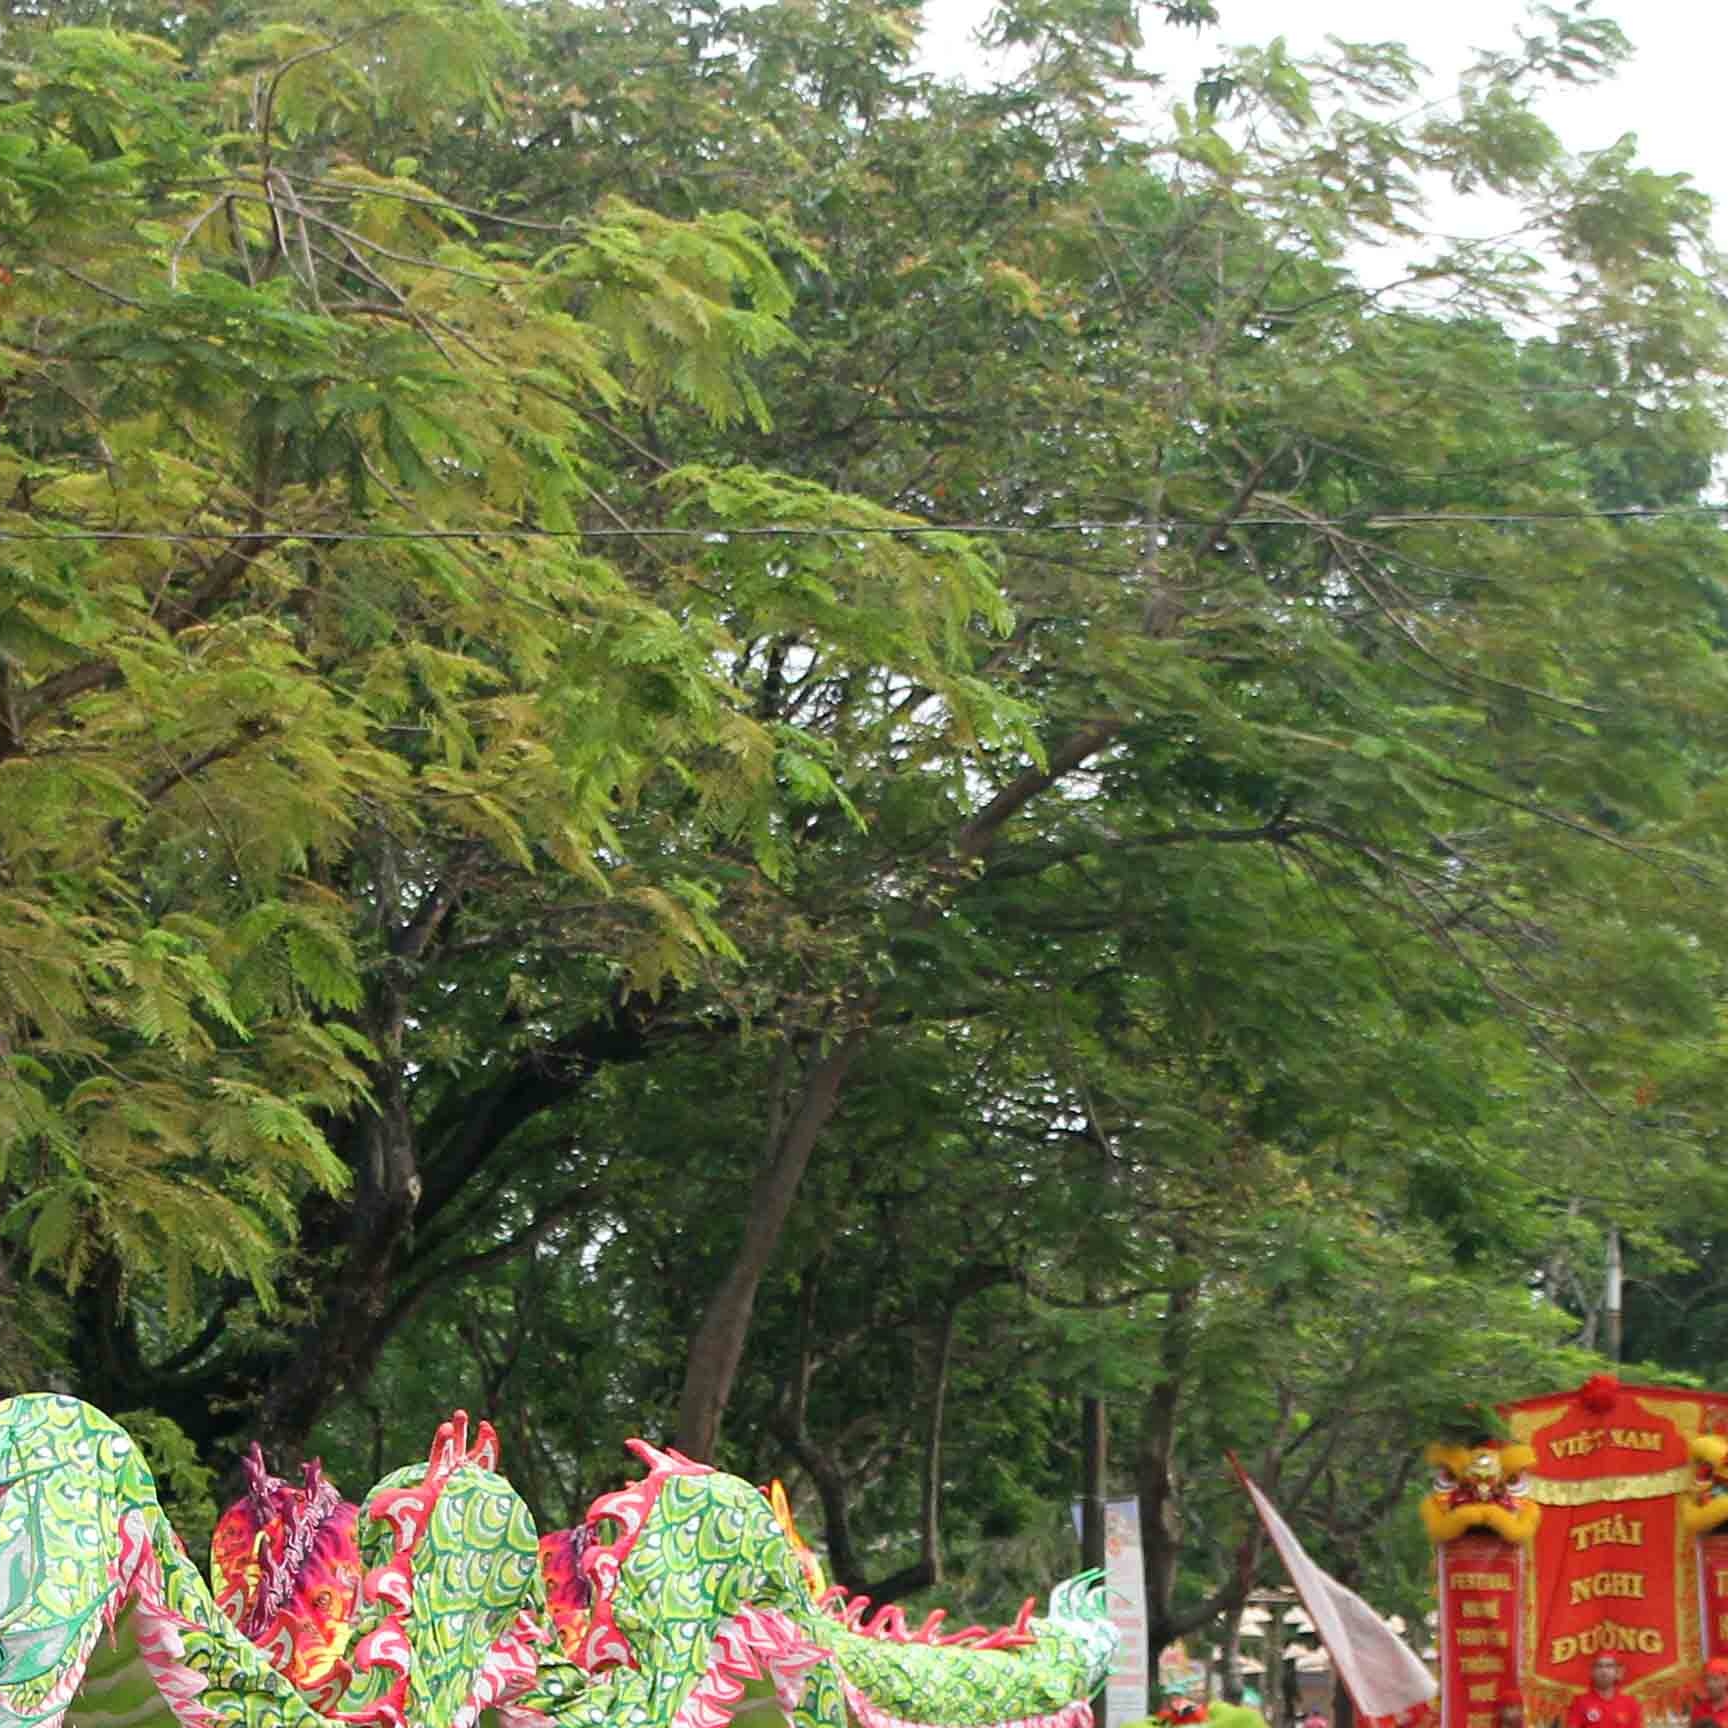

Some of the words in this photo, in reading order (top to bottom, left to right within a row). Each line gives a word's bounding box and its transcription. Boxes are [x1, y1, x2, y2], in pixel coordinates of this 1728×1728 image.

[1609, 1428, 1663, 1451] NAM
[1570, 1513, 1643, 1551] THÁI
[1569, 1571, 1645, 1605] NGHI
[1550, 1619, 1665, 1665] ĐƯỜNG
